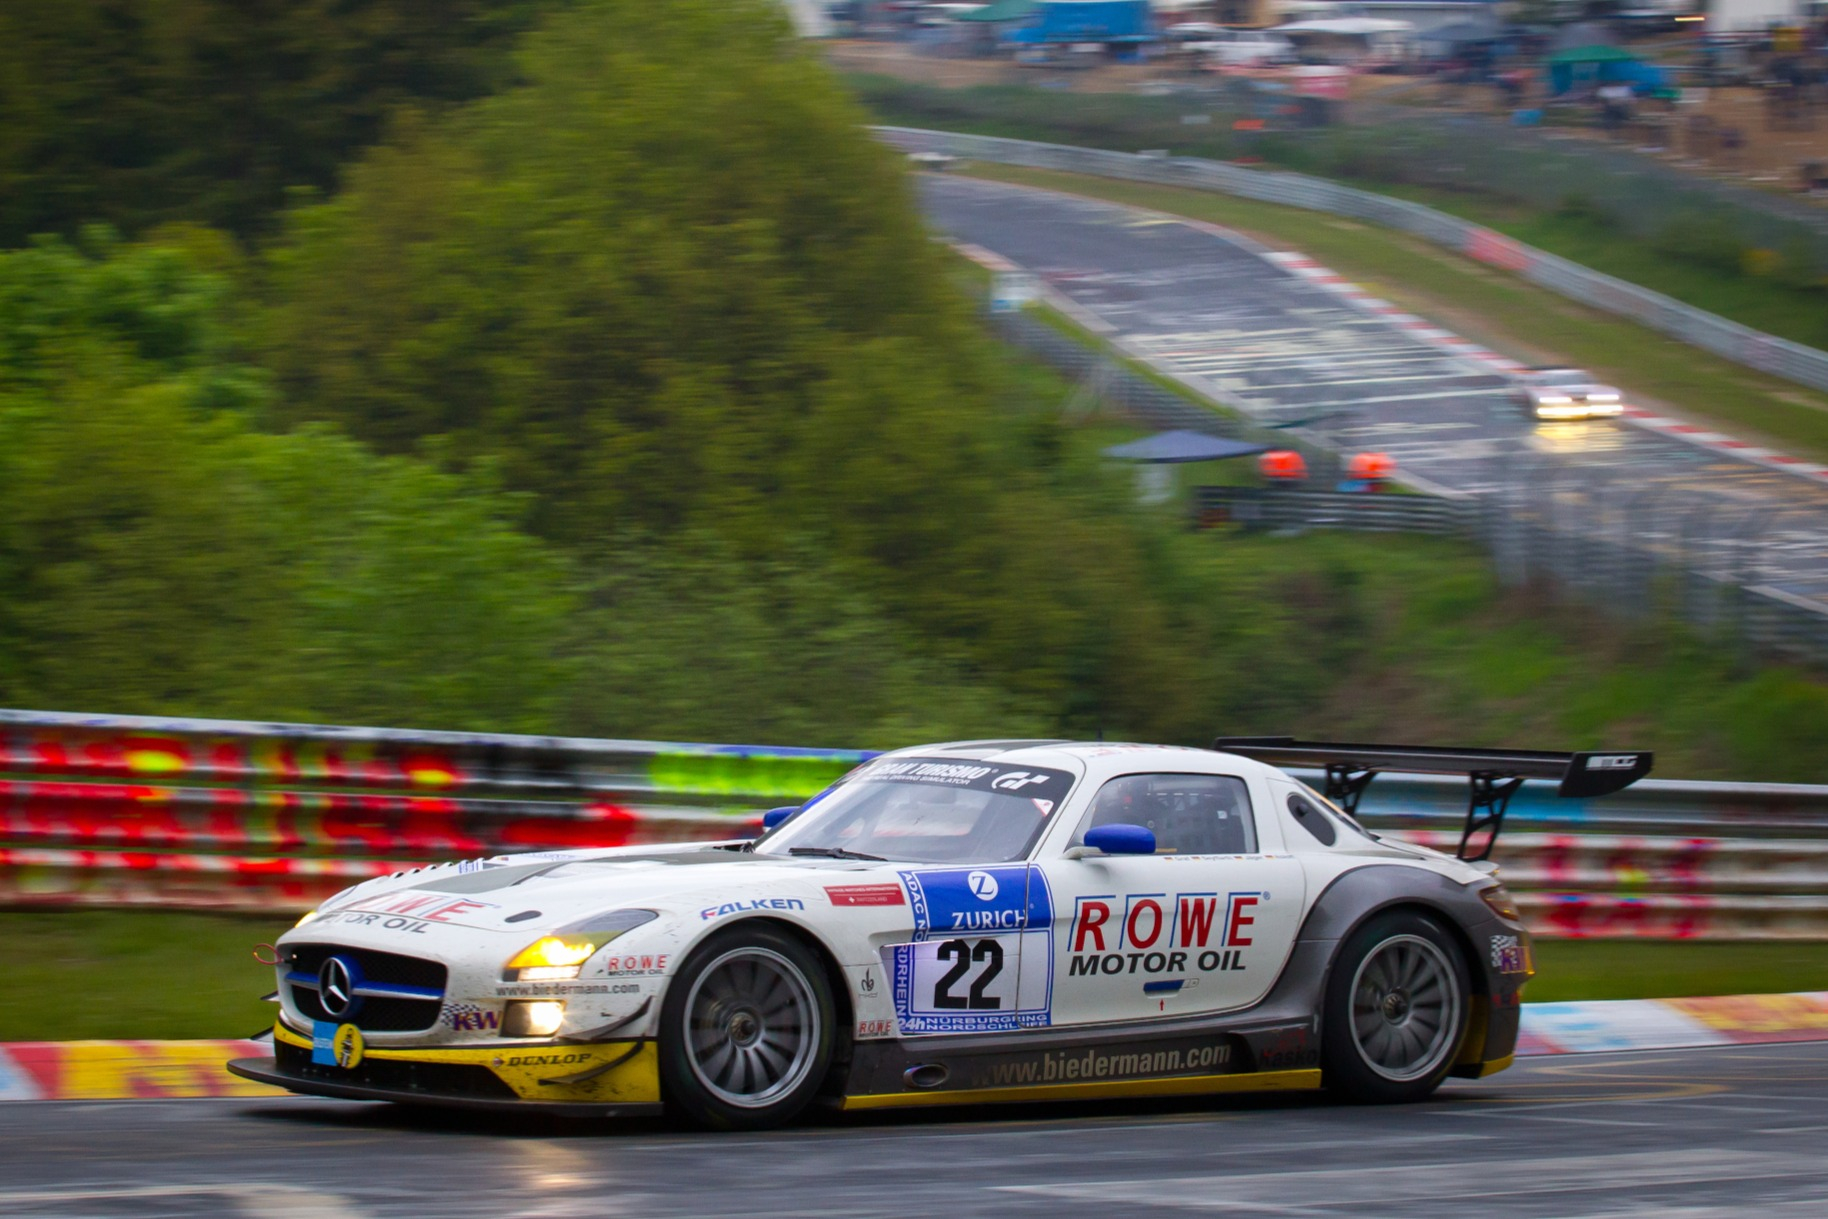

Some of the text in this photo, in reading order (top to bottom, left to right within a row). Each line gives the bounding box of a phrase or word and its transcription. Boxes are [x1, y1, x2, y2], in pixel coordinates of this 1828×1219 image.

[909, 763, 991, 779] TURISMO
[920, 777, 970, 785] SIMULATOR
[901, 872, 924, 914] ADAC
[700, 898, 805, 921] FALKEN
[383, 917, 431, 934] OIL
[952, 910, 1028, 930] ZURICH
[1069, 893, 1260, 952] ROWE
[608, 955, 667, 970] ROWE
[1069, 950, 1246, 976] MOTOR OIL
[934, 939, 1004, 1009] 22
[496, 983, 640, 997] www.biedermann.com
[454, 1011, 499, 1031] KW
[858, 1021, 892, 1033] ROWE
[899, 1013, 1048, 1031] 24h NÜRBURGRING
[508, 1054, 592, 1066] DUNLOP
